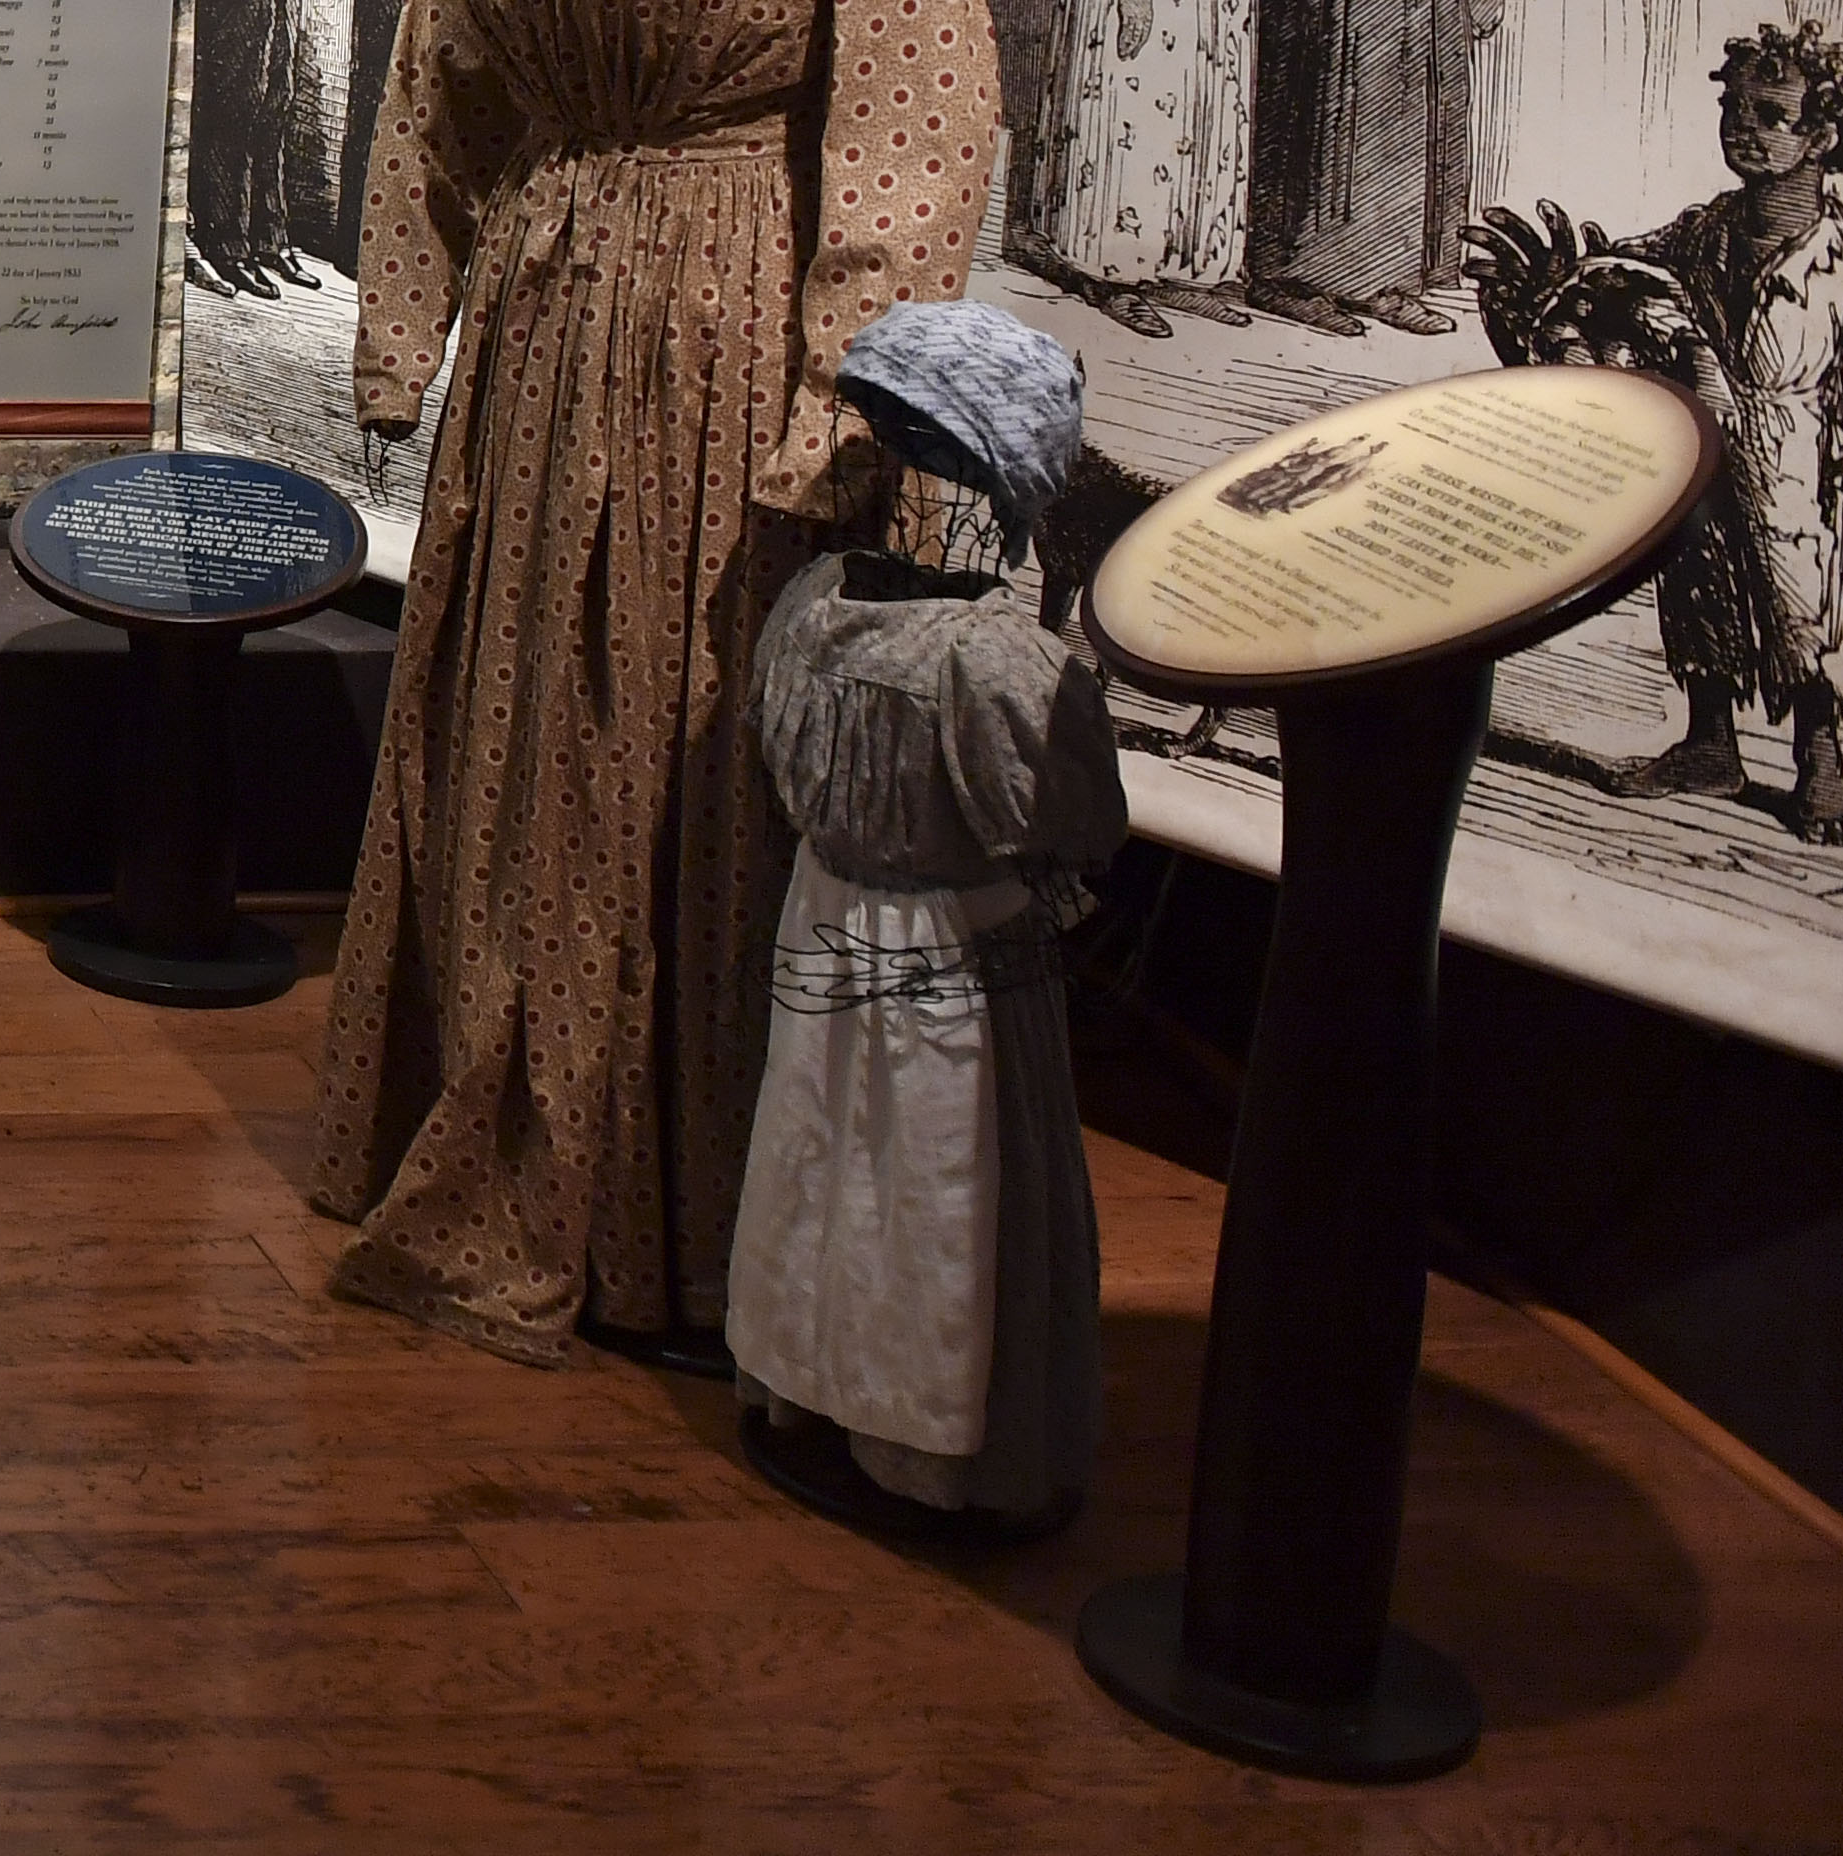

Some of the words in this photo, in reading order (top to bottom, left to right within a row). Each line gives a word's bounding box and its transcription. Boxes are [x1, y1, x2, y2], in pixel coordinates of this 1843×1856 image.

[74, 499, 106, 509] THIS
[110, 503, 153, 514] DRESS
[155, 508, 194, 519] THEY
[196, 514, 225, 523] LAY
[226, 518, 270, 530] ASIDE
[271, 524, 317, 535] AFTER
